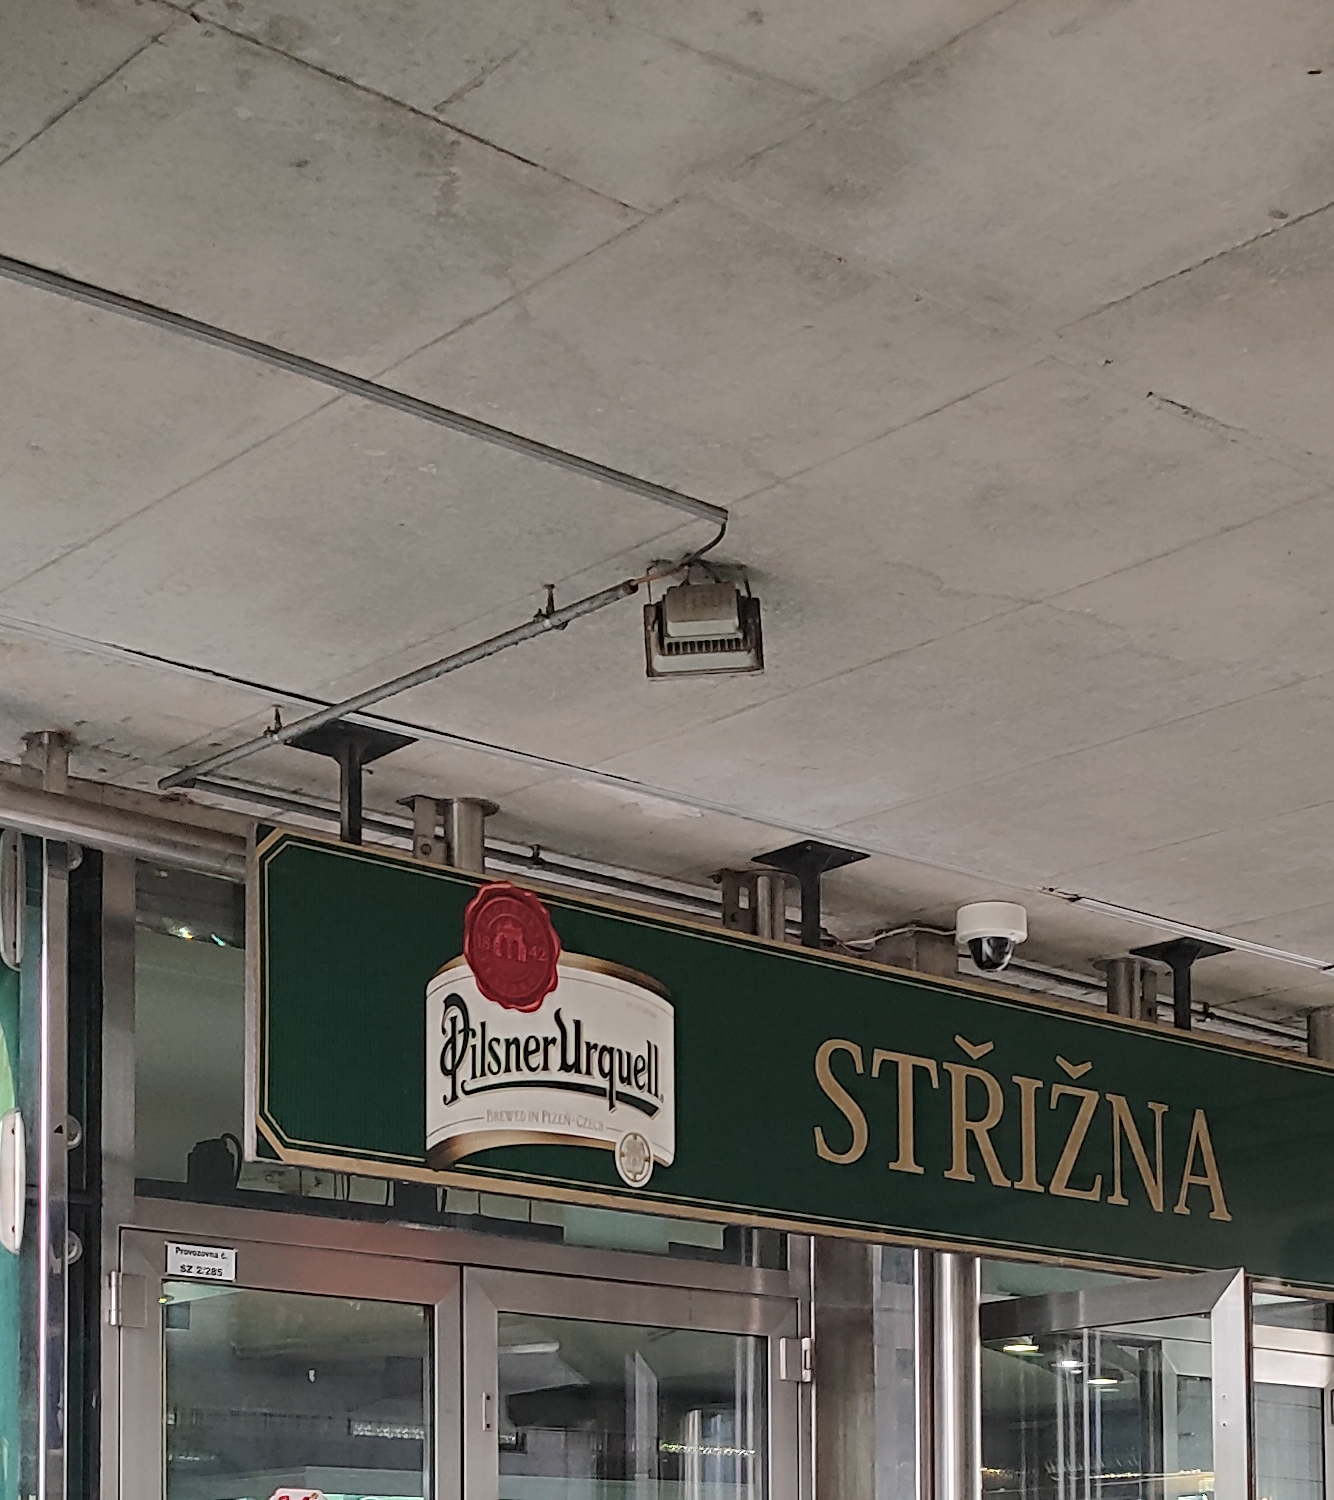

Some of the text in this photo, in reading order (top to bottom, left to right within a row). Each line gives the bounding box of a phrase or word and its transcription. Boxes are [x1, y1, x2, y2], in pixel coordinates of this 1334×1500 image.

[440, 993, 660, 1112] Pilsner Urquell
[813, 1033, 1233, 1222] STŘIŽNA
[175, 1246, 219, 1259] Provozovna
[179, 1263, 194, 1274] SZ
